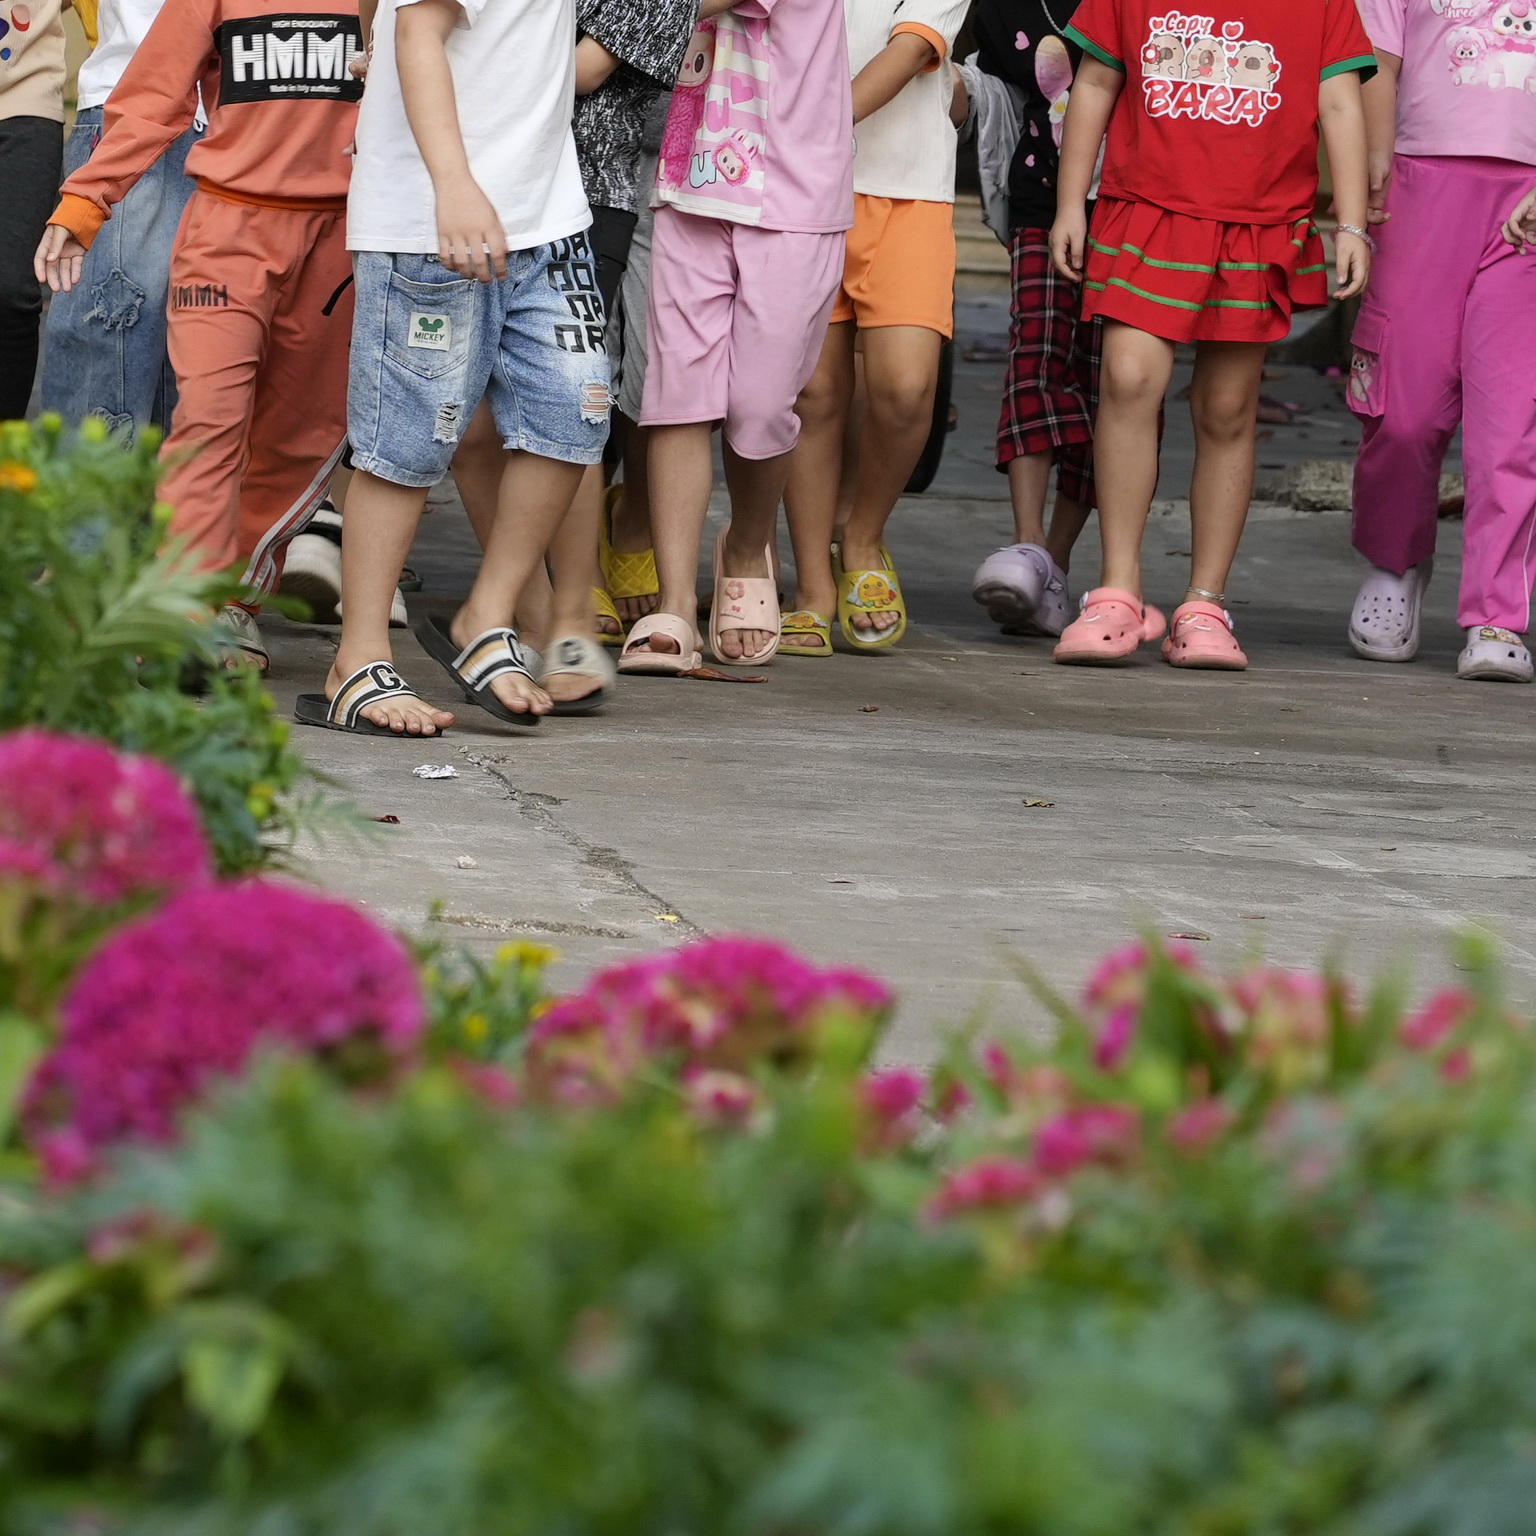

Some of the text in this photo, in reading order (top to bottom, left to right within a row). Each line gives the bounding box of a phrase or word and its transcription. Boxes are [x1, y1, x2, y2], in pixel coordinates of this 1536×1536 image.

[1165, 10, 1215, 37] Capy
[1142, 78, 1267, 127] BARA
[414, 331, 445, 342] MICKEY
